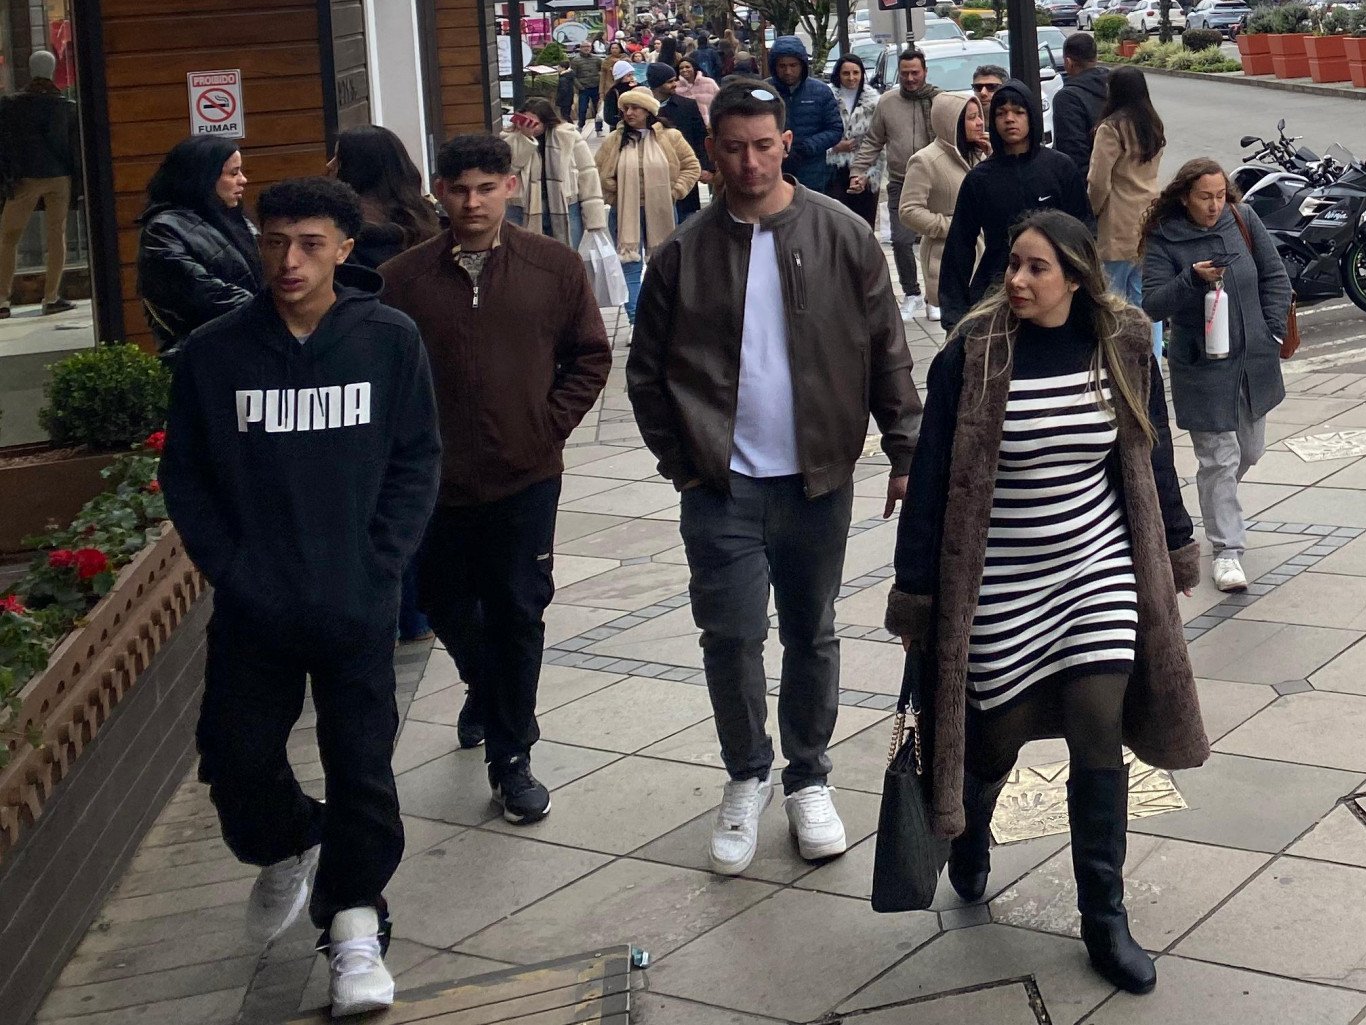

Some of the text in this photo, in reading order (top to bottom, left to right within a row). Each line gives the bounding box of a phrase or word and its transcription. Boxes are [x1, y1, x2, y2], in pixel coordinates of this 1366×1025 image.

[193, 74, 235, 86] PROIBIDO
[198, 122, 237, 133] FUMAR
[235, 381, 371, 433] PUMA
